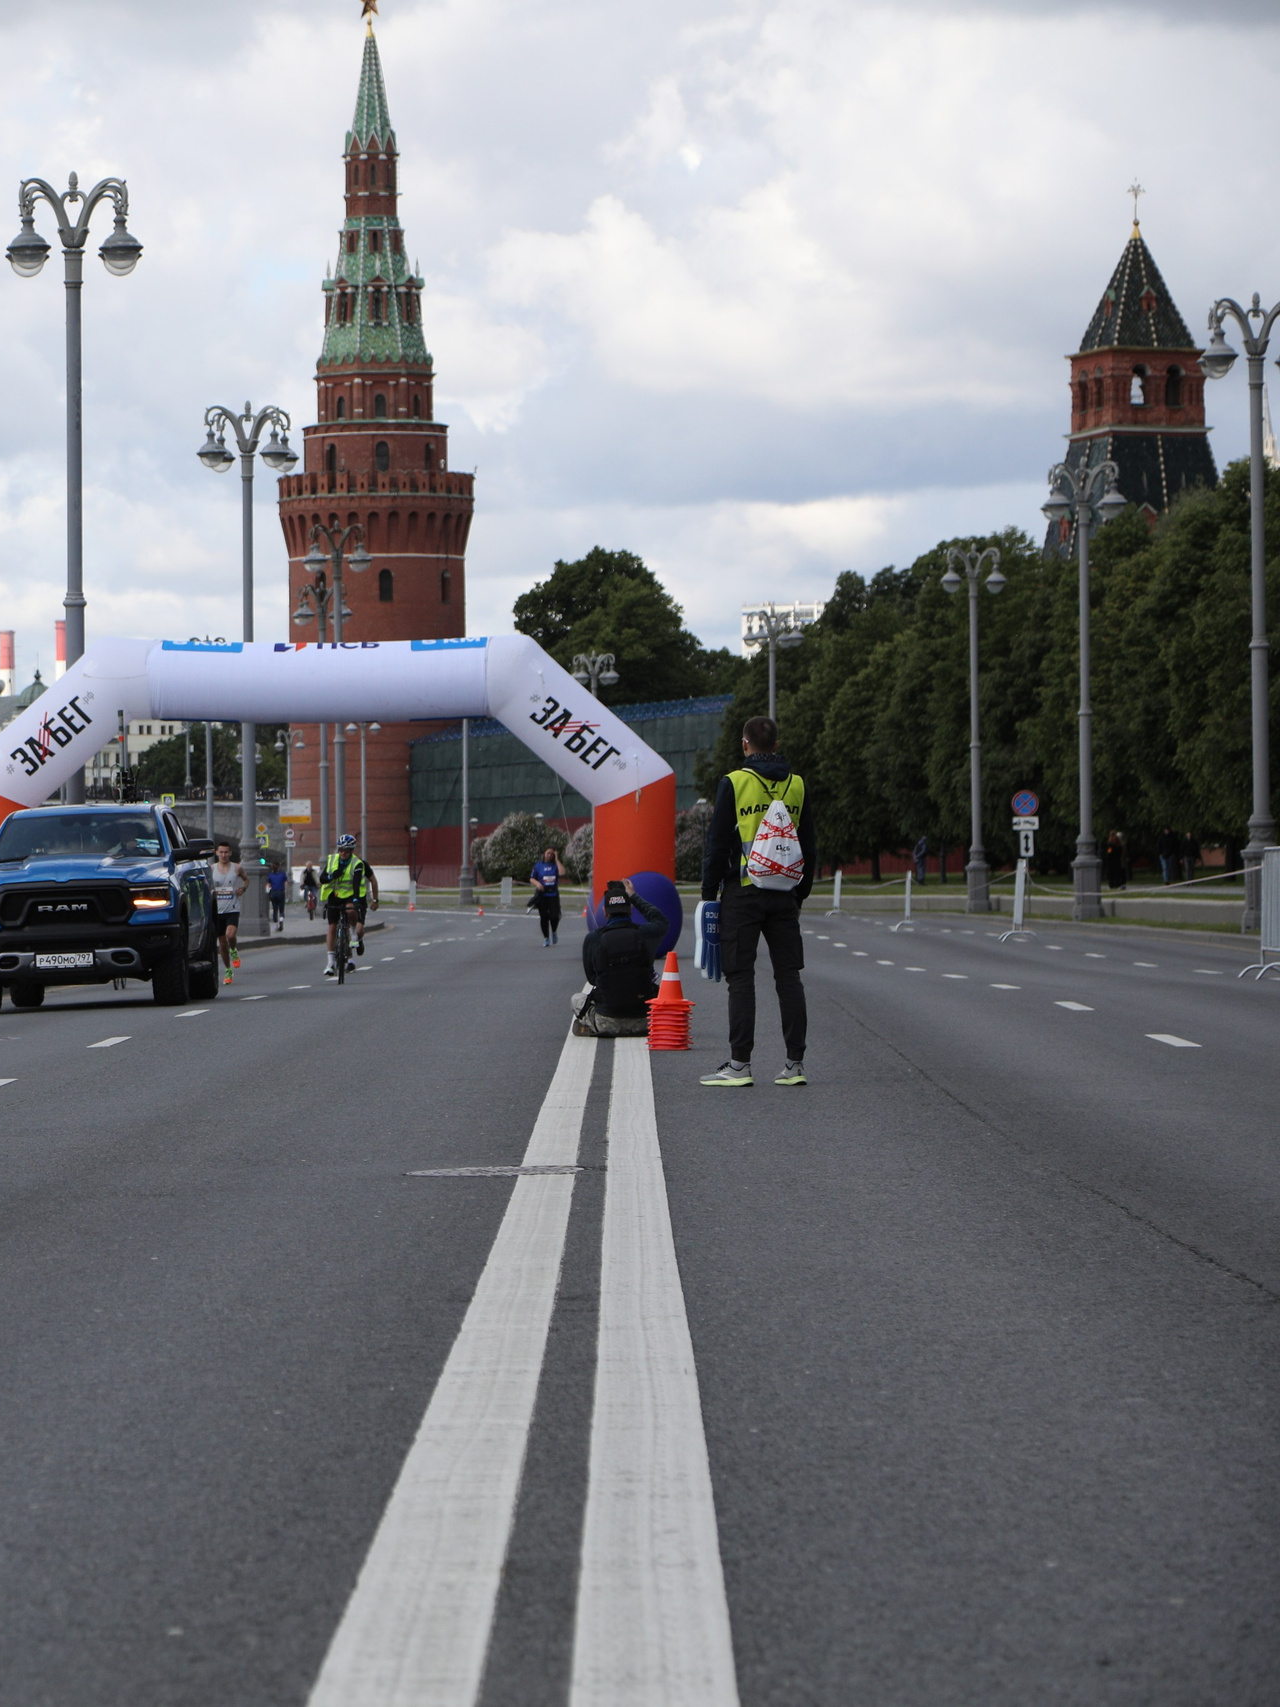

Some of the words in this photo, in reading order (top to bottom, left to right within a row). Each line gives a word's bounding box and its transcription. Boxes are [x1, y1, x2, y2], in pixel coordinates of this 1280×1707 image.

[740, 804, 800, 817] МАРАЛ
[38, 904, 88, 912] RAM
[77, 953, 91, 962] 797
